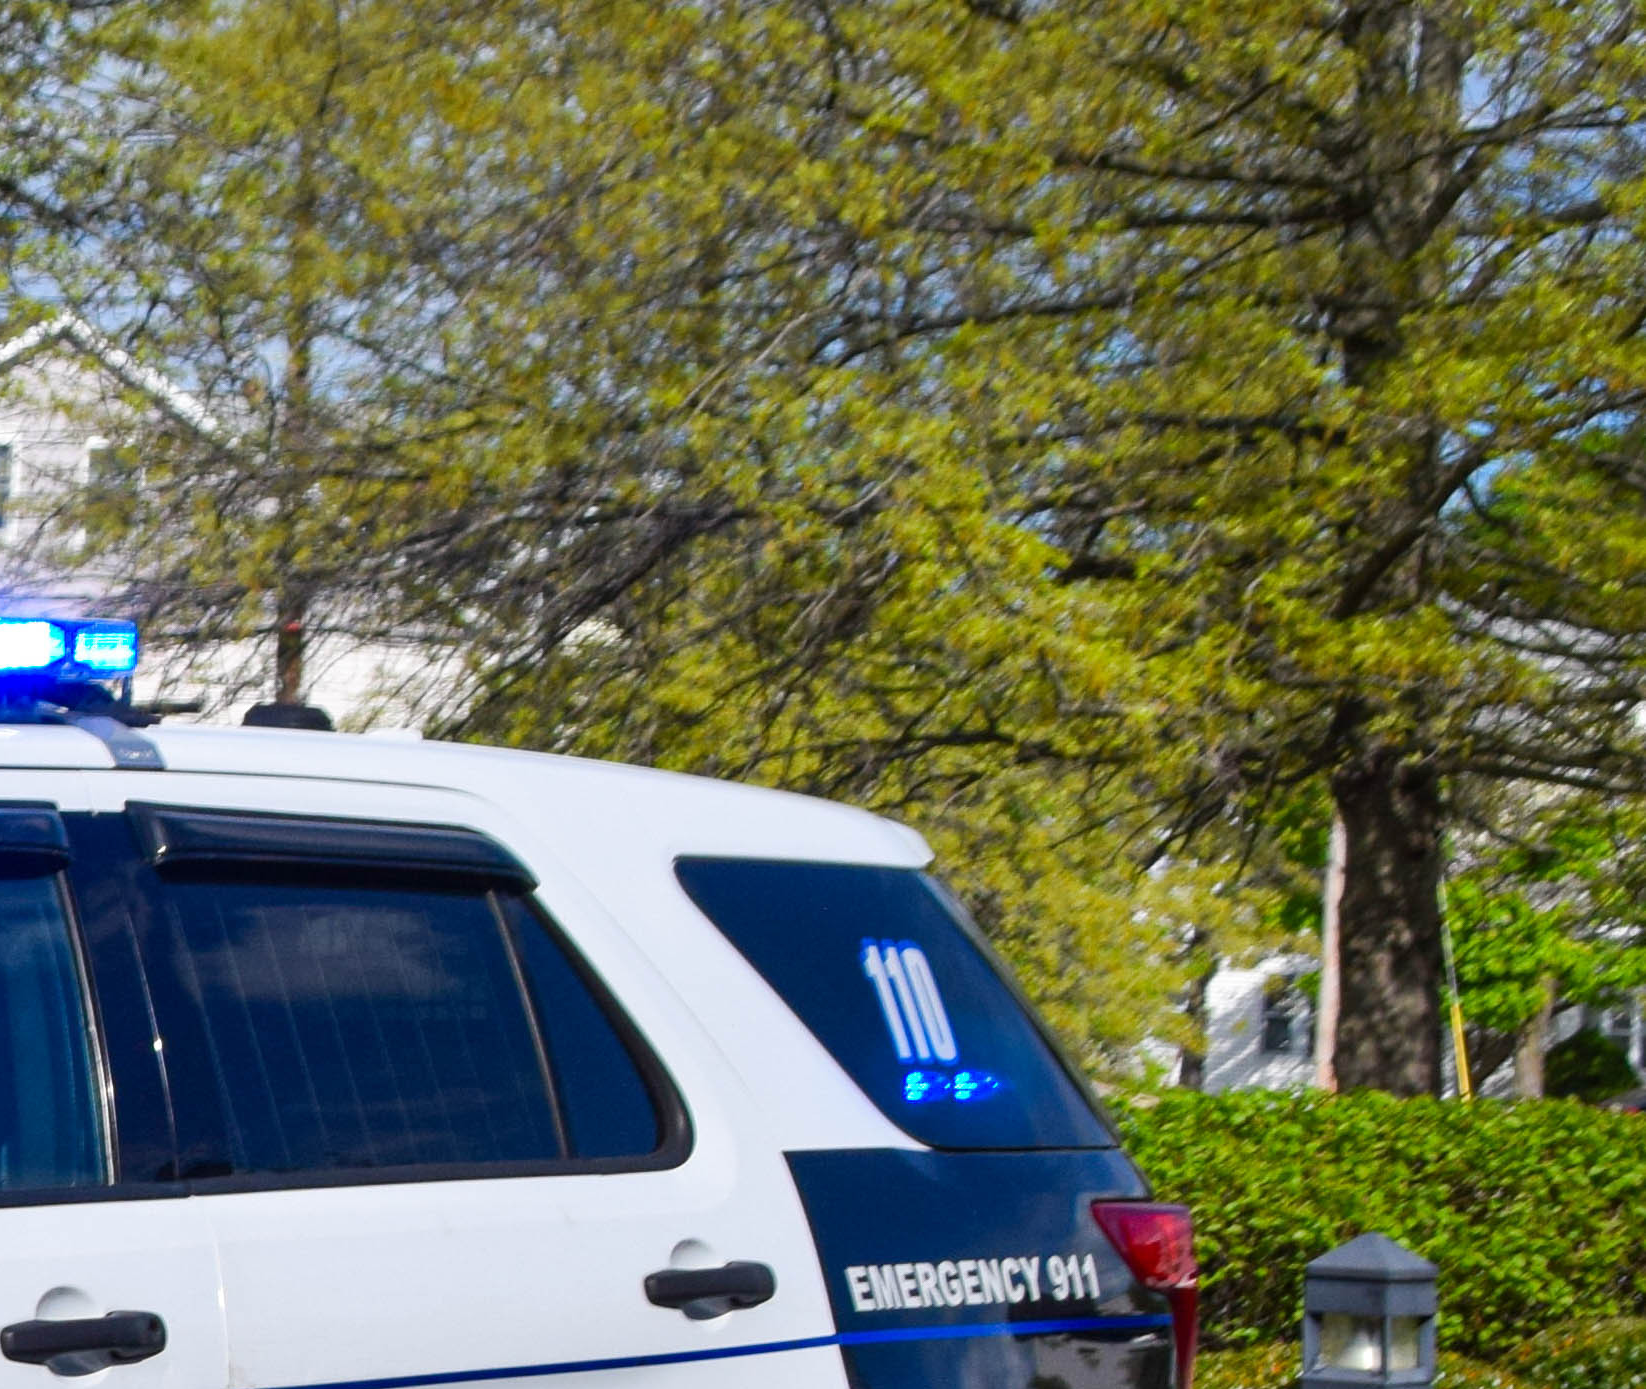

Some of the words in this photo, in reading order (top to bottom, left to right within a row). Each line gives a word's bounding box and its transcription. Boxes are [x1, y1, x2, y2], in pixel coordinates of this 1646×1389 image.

[861, 938, 959, 1064] 110
[844, 1256, 1041, 1312] EMERGENCY
[1046, 1253, 1101, 1301] 911
